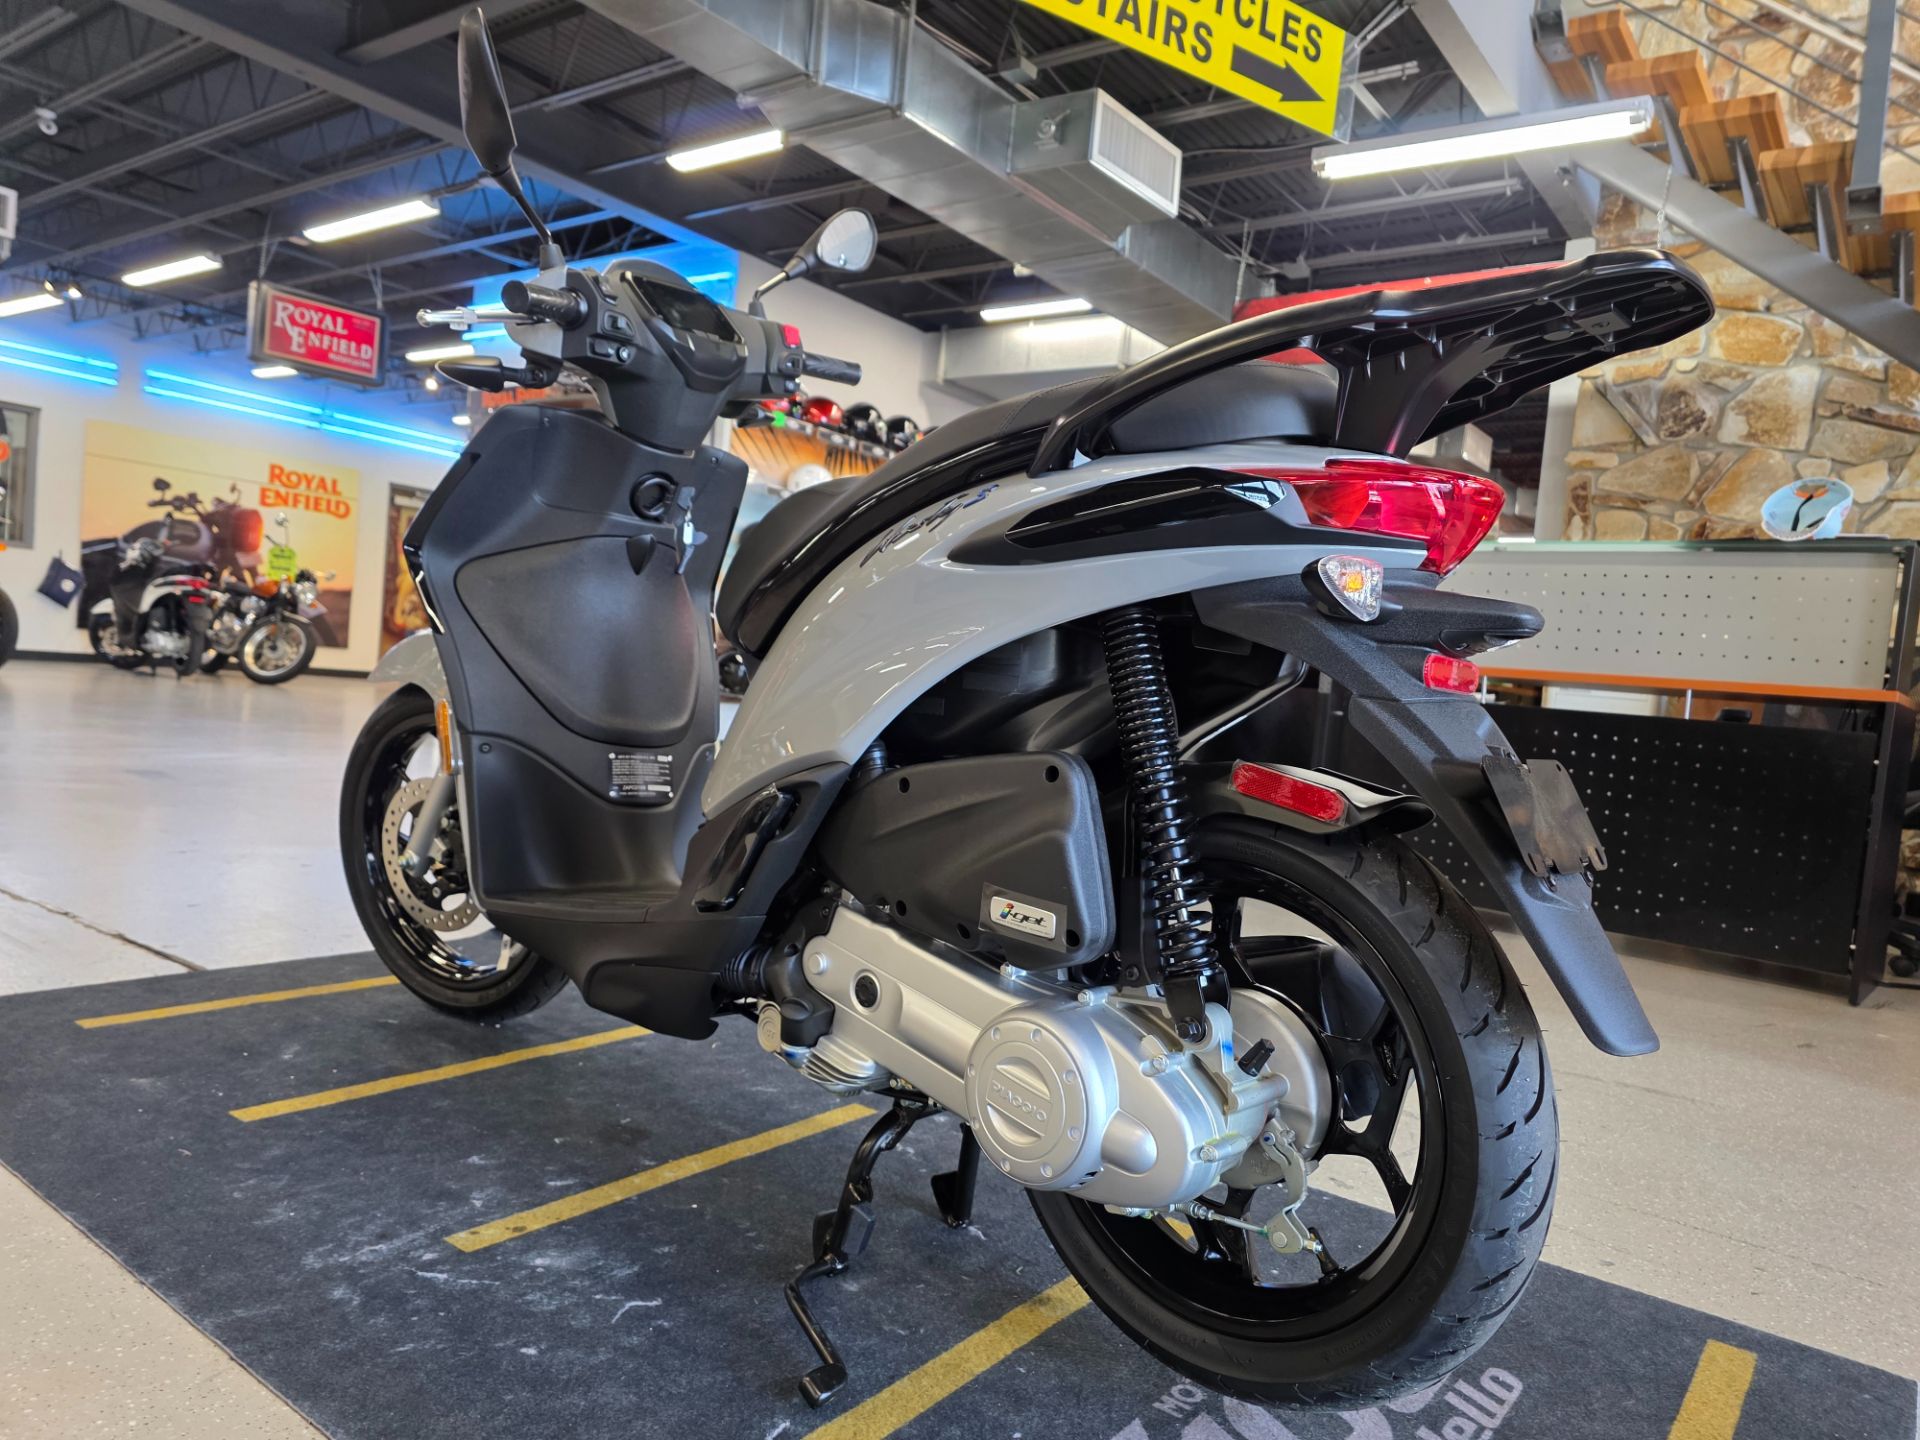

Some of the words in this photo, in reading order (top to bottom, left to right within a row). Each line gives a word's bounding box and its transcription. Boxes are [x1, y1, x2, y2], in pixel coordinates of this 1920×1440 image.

[274, 300, 349, 336] ROYAL
[291, 326, 373, 360] ENFIELD
[268, 463, 342, 497] ROYAL
[258, 486, 352, 520] ENFIELD
